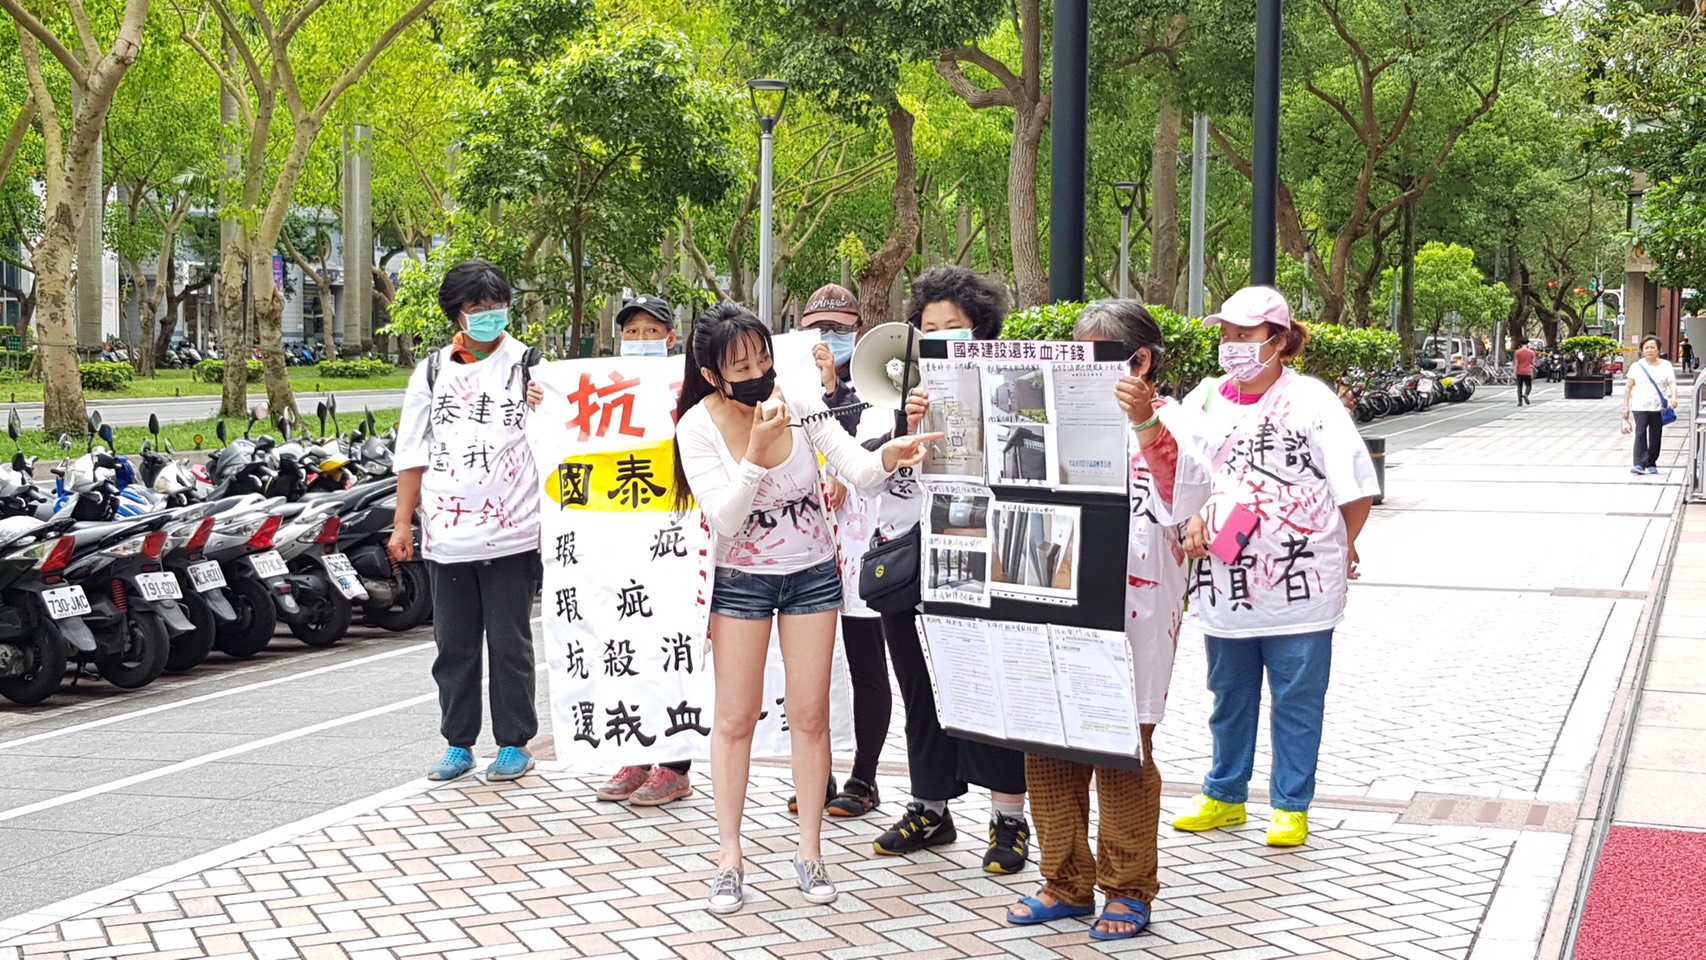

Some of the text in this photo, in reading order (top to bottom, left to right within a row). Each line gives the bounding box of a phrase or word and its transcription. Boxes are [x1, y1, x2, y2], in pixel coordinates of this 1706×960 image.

[953, 341, 1086, 362] 國泰建設還我血汗錢
[564, 370, 685, 442] 抗
[559, 453, 667, 511] 國泰
[142, 580, 180, 597] 191-GDV
[48, 594, 89, 615] 730-JAC
